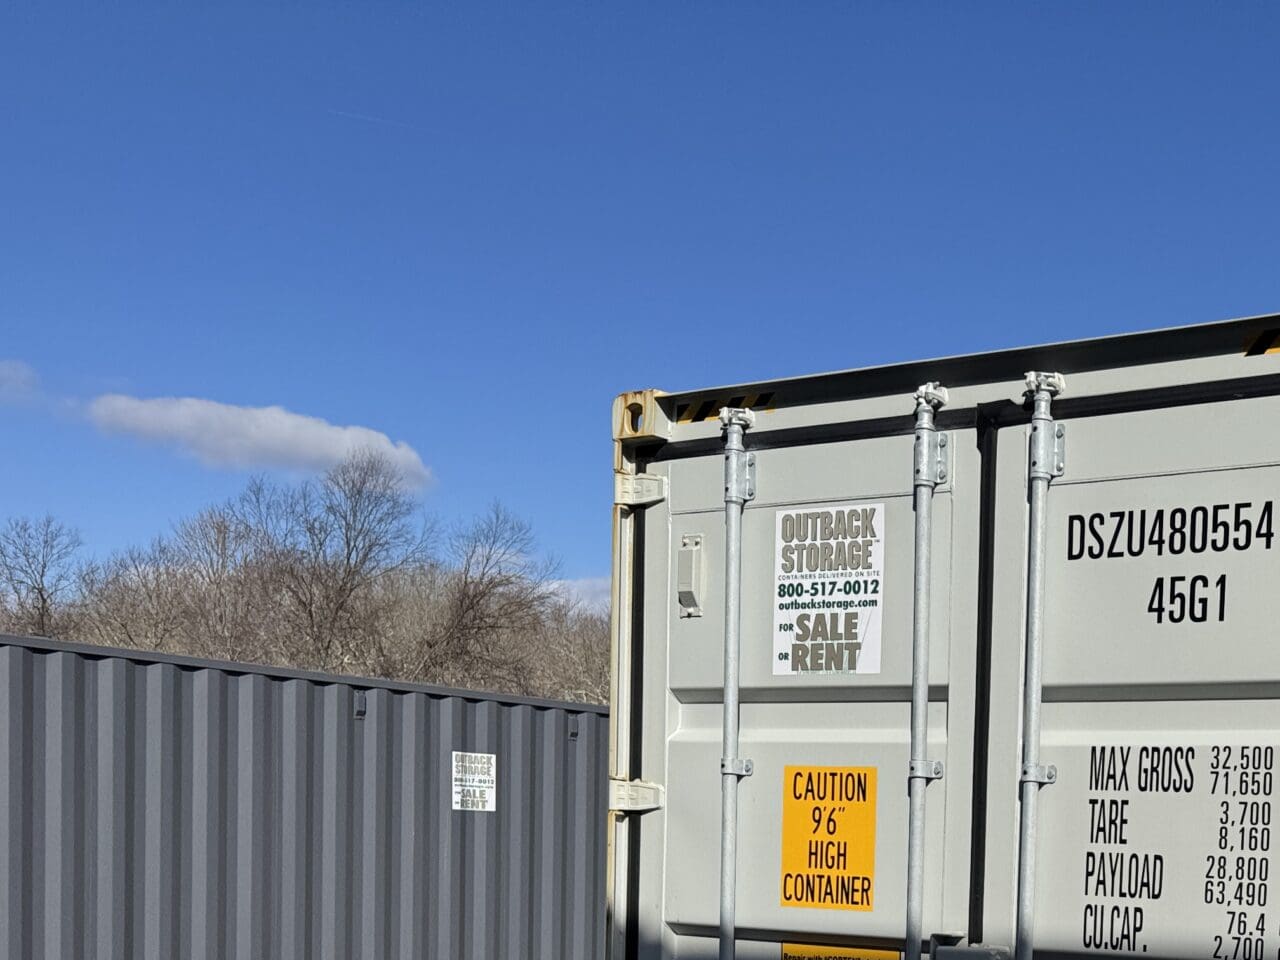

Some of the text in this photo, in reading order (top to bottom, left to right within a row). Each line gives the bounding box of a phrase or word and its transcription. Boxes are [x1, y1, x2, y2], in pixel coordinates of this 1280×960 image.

[781, 508, 877, 543] OUTBACK
[1067, 500, 1274, 561] DSZU480554
[781, 539, 873, 574] STORAGE
[778, 573, 816, 581] CONTAINERS
[778, 579, 880, 598] 800-517-0012
[778, 599, 878, 611] outbackstorage.com
[1148, 574, 1227, 624] 45G1
[779, 612, 859, 642] FOR SALE
[778, 642, 862, 671] OR RENT
[1089, 746, 1131, 791] MAX
[1137, 746, 1196, 793] GROSS
[1210, 746, 1274, 772] 32,500
[1210, 771, 1273, 797] 71,650
[793, 771, 867, 802] CAUTION
[1088, 799, 1129, 845] TARE
[1219, 801, 1271, 827] 3,700
[1218, 826, 1270, 852] 8,160
[808, 840, 848, 870] HIGH
[783, 873, 871, 906] CONTAINER
[1084, 851, 1164, 900] PAYLOAD
[1205, 855, 1269, 882] 28,800
[1203, 880, 1268, 907] 63,490
[1083, 903, 1148, 953] CU.CAP.
[1226, 911, 1266, 937] 76.4
